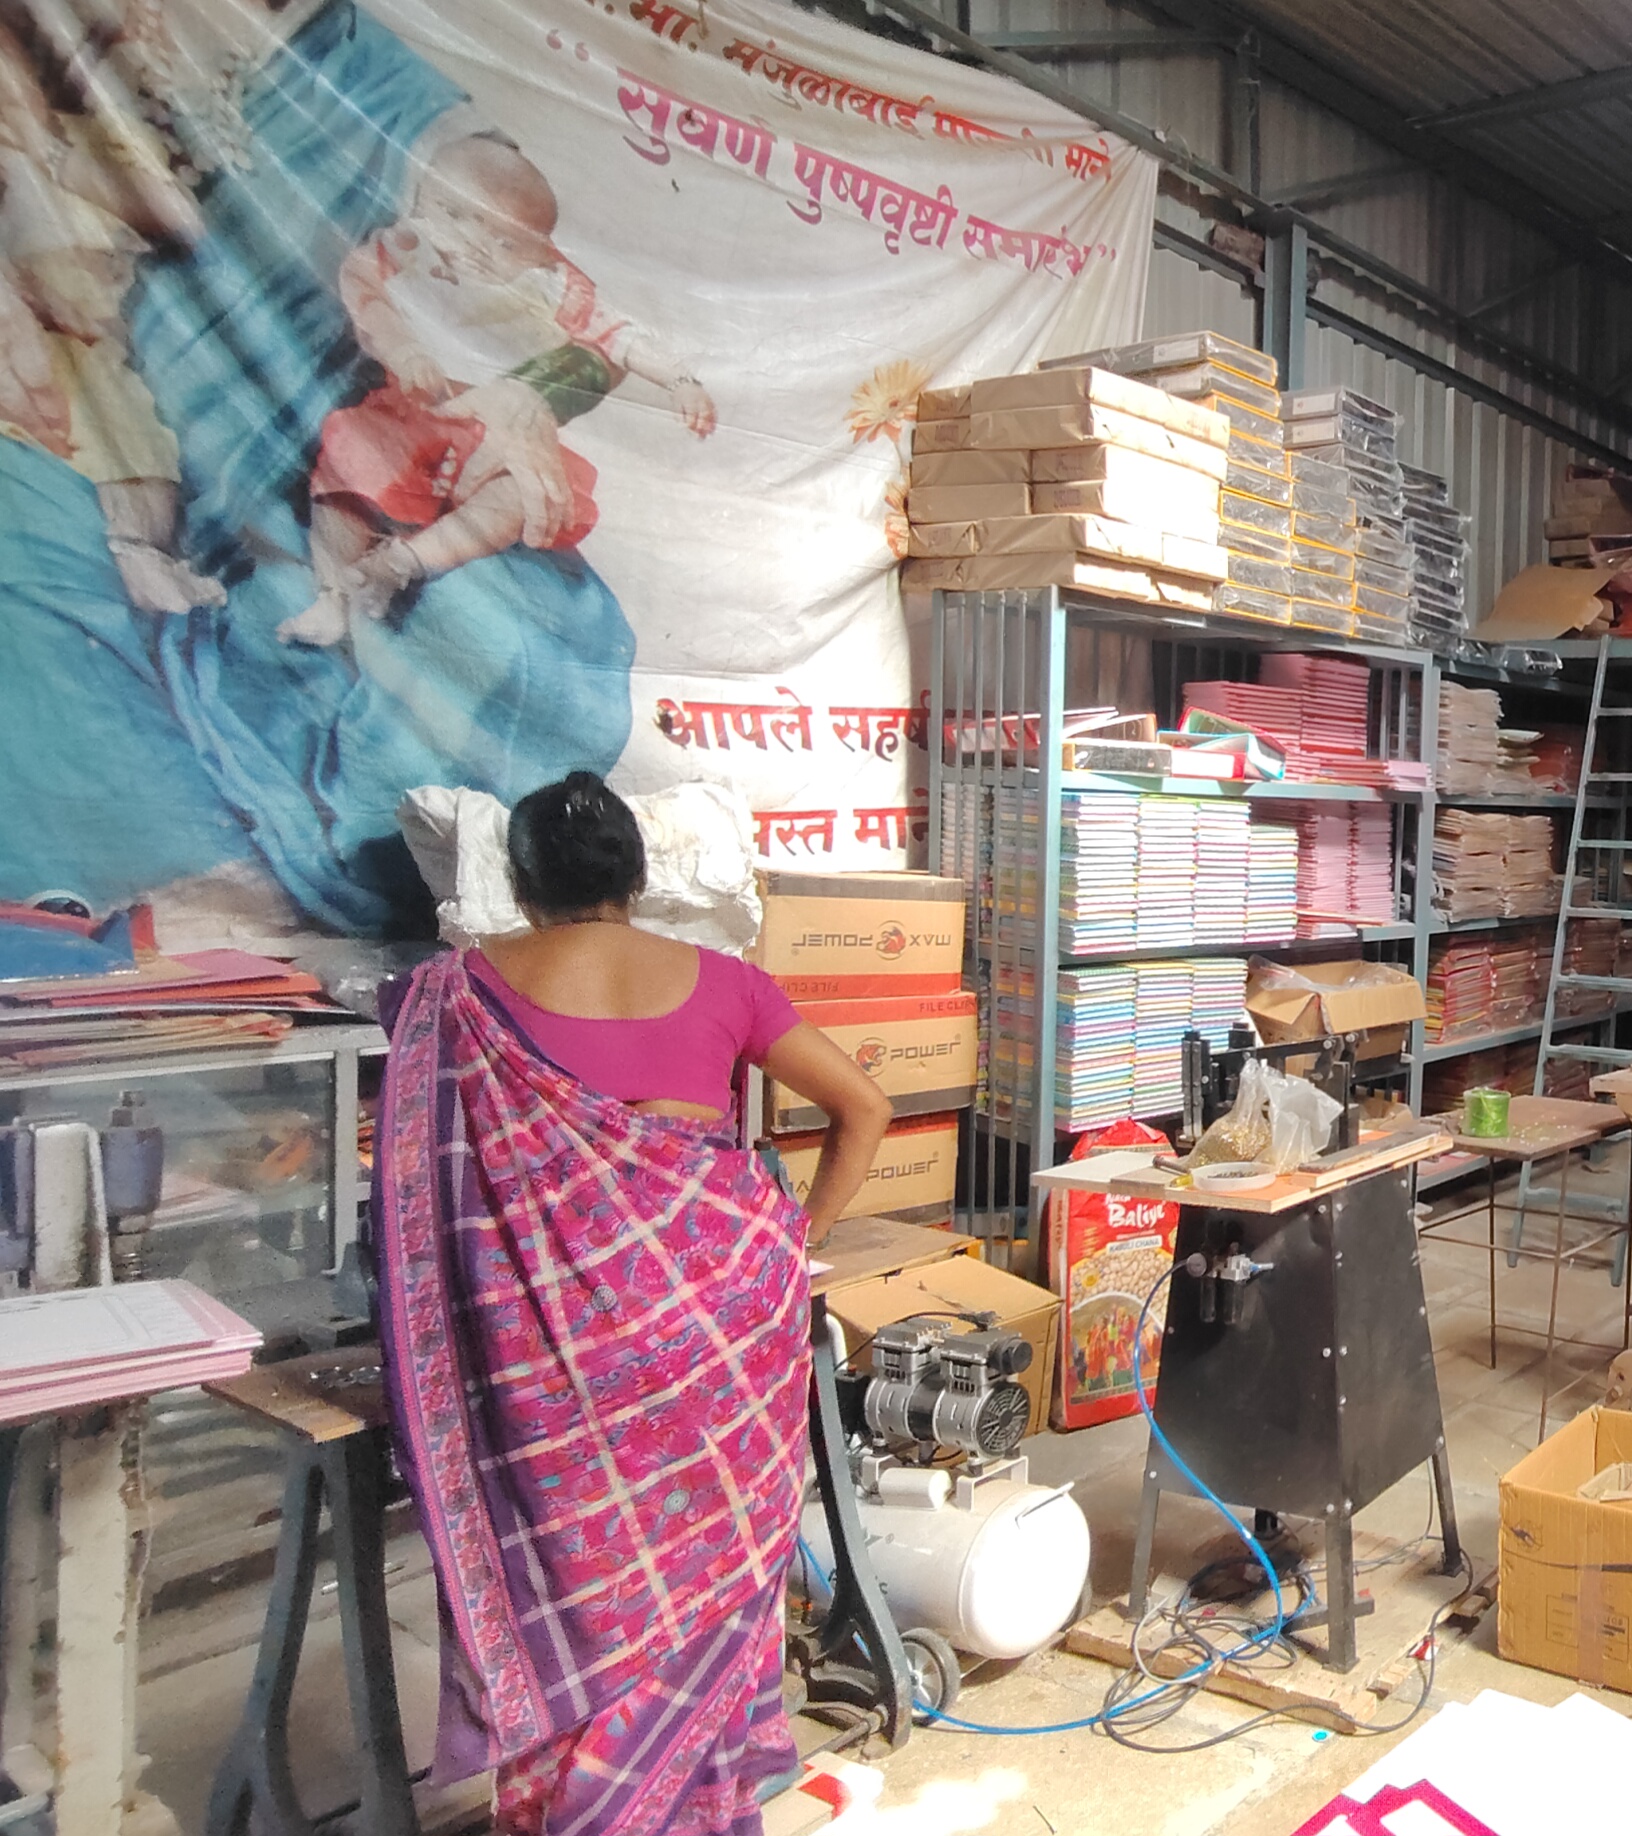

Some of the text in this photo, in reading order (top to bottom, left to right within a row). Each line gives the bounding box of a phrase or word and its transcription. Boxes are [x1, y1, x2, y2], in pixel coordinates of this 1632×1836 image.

[786, 142, 959, 256] पुष्पवृष्टी
[652, 686, 813, 752] आपले
[791, 933, 952, 948] MAX POWER
[919, 1001, 944, 1012] FILE
[889, 1041, 962, 1062] POWER
[865, 1158, 939, 1183] POWER
